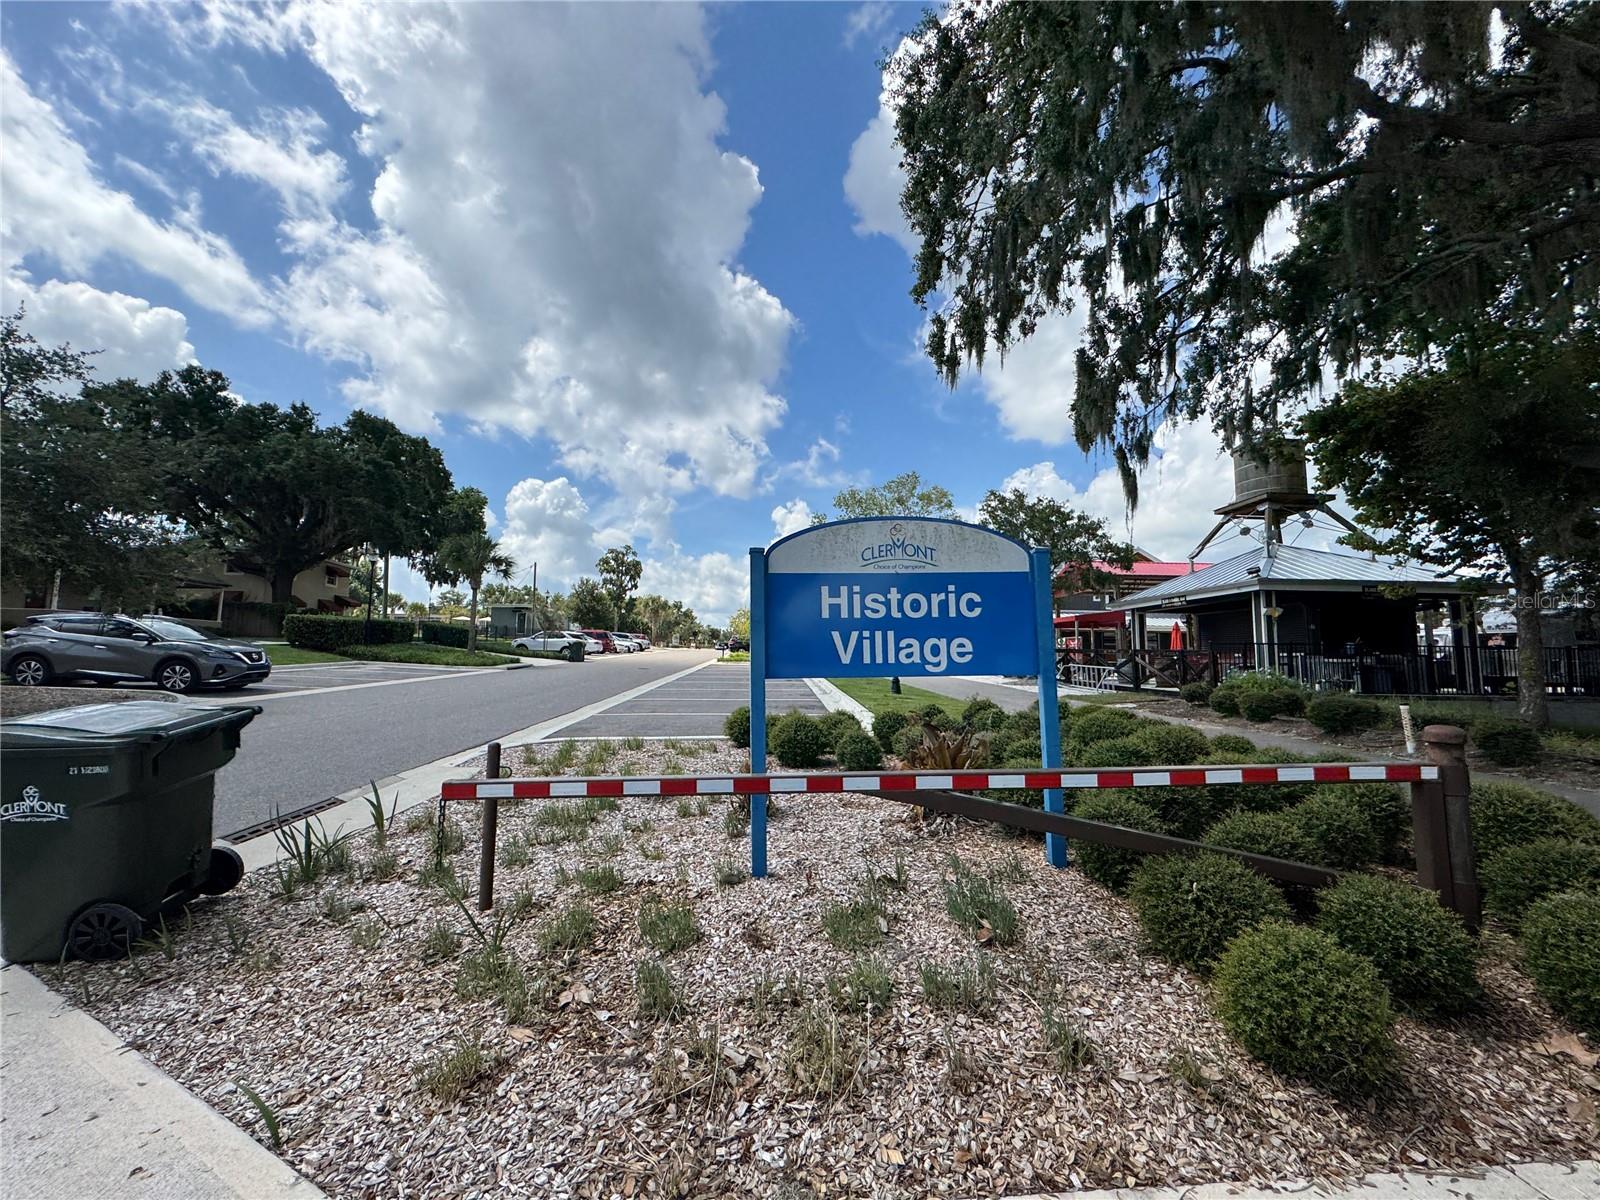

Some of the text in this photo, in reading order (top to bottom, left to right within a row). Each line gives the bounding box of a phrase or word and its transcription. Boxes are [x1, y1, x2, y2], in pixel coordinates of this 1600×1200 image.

[861, 536, 936, 561] CLERMONT
[820, 585, 983, 619] Historic
[831, 630, 974, 673] Village
[0, 796, 67, 815] CLERMONT
